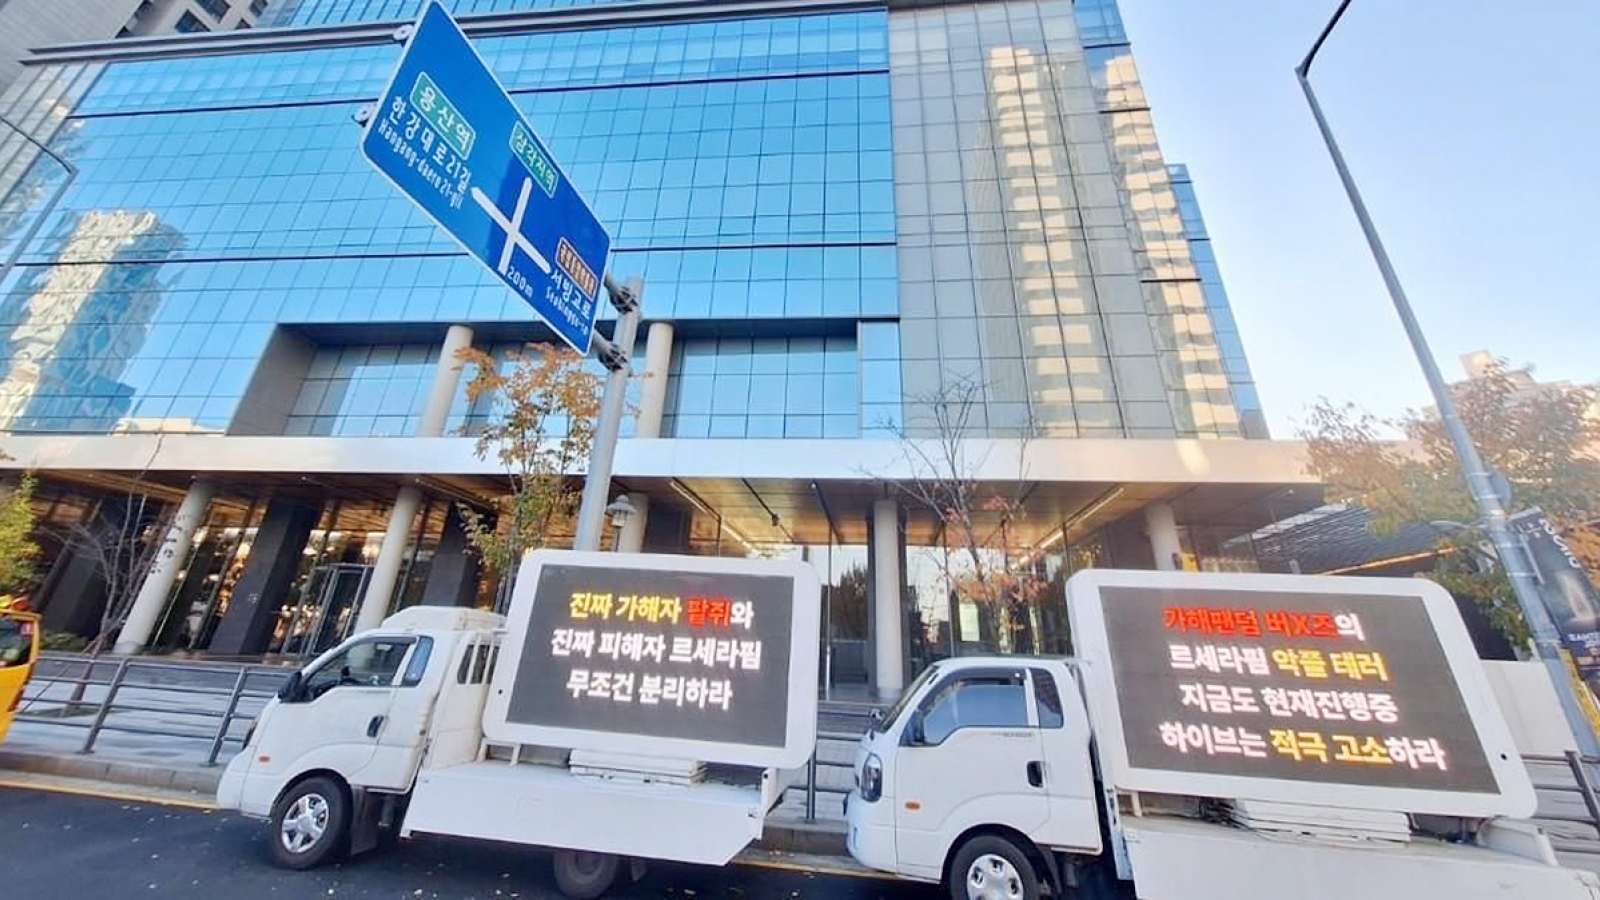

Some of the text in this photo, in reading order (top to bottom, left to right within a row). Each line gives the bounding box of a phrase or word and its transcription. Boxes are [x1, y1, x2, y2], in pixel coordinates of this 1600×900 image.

[420, 84, 474, 154] 용산역
[516, 132, 556, 192] 삼각지역
[508, 265, 533, 297] 200m
[551, 270, 592, 320] 서빙고로
[570, 593, 754, 630] 진짜 가해자 팥쥐와
[1163, 607, 1261, 637] 가해팬덤
[551, 629, 762, 670] 진짜 피해자 르세라핌
[1169, 644, 1389, 682] 르세라핌 악플 테러
[567, 669, 733, 711] 무조건 분리하라
[1180, 682, 1399, 723] 지금도 현재진행중
[1159, 720, 1446, 771] 하이브는 적극 고소하라
